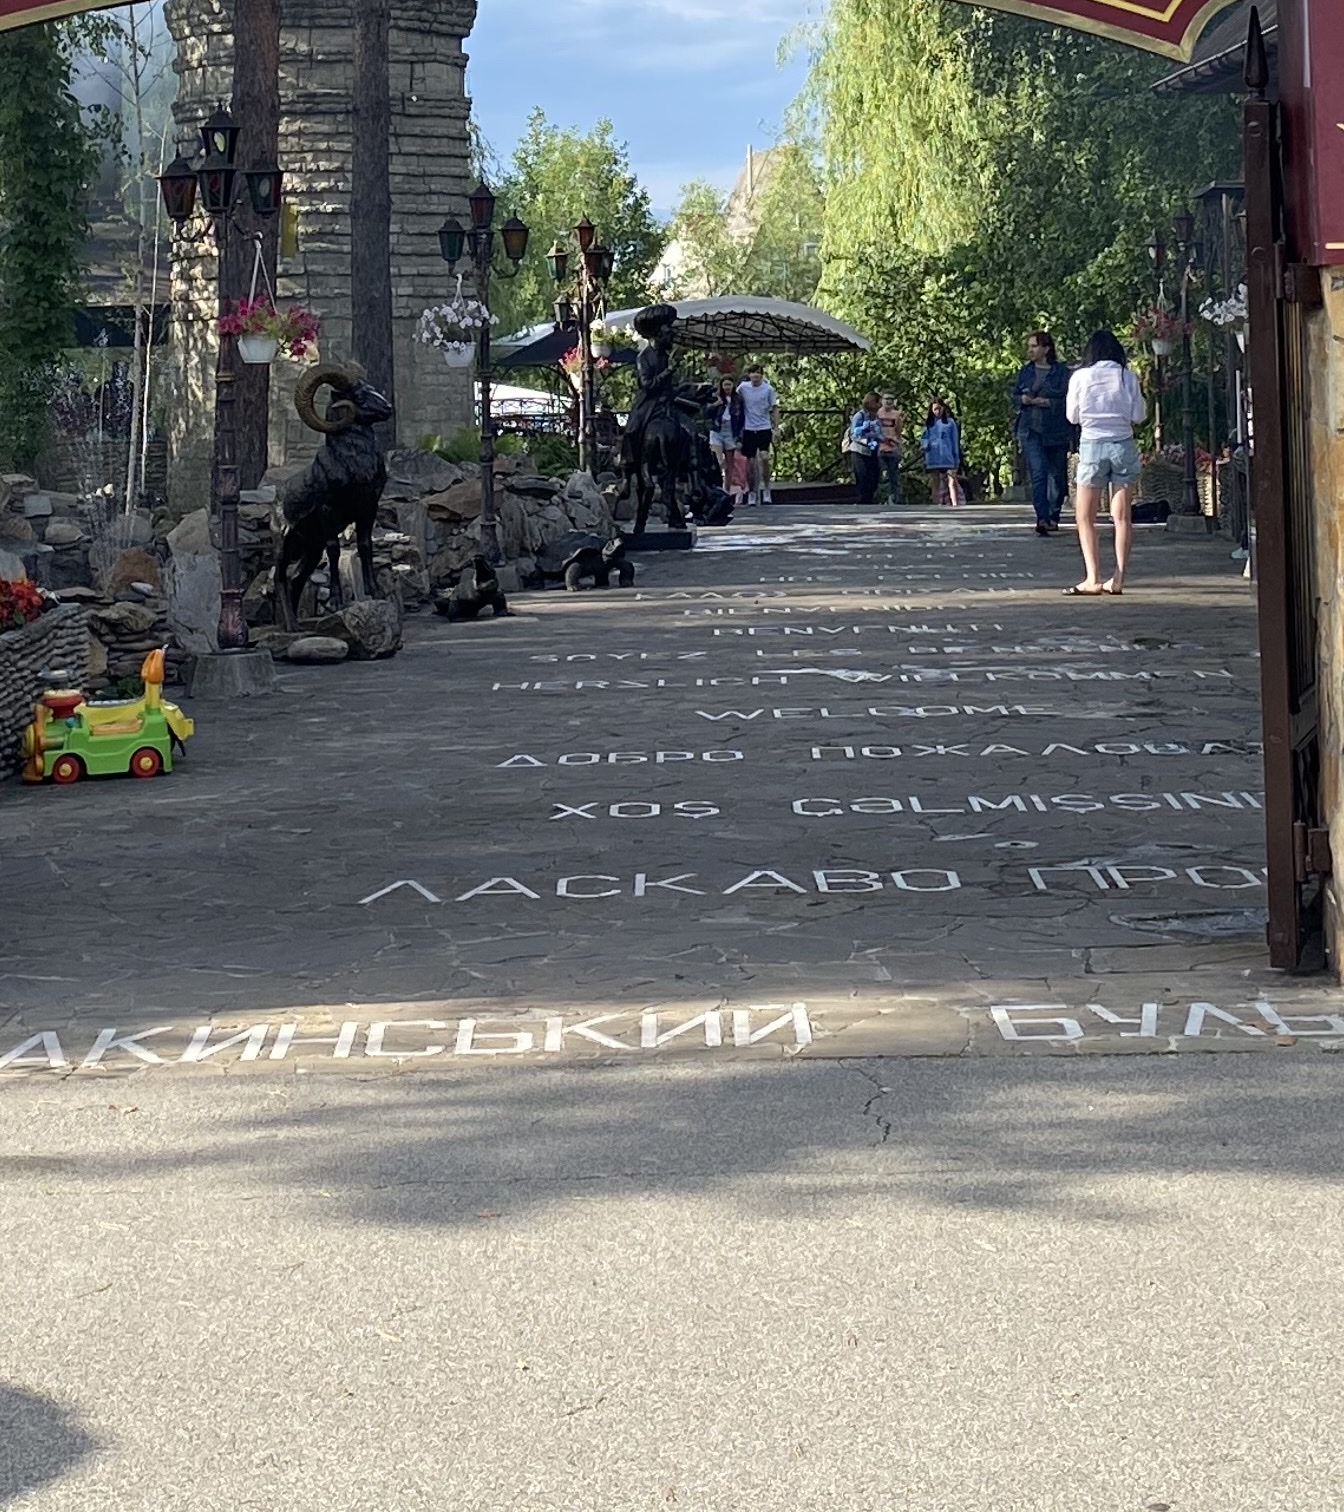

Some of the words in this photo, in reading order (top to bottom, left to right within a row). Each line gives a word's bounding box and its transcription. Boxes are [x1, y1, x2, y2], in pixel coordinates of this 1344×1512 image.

[694, 703, 1063, 720] WELCOME
[495, 750, 745, 767] ДОБРО
[810, 741, 1263, 759] ПОЖАЛОВА
[357, 869, 961, 904] ЛАСКАВО
[1028, 866, 1267, 889] ПРО
